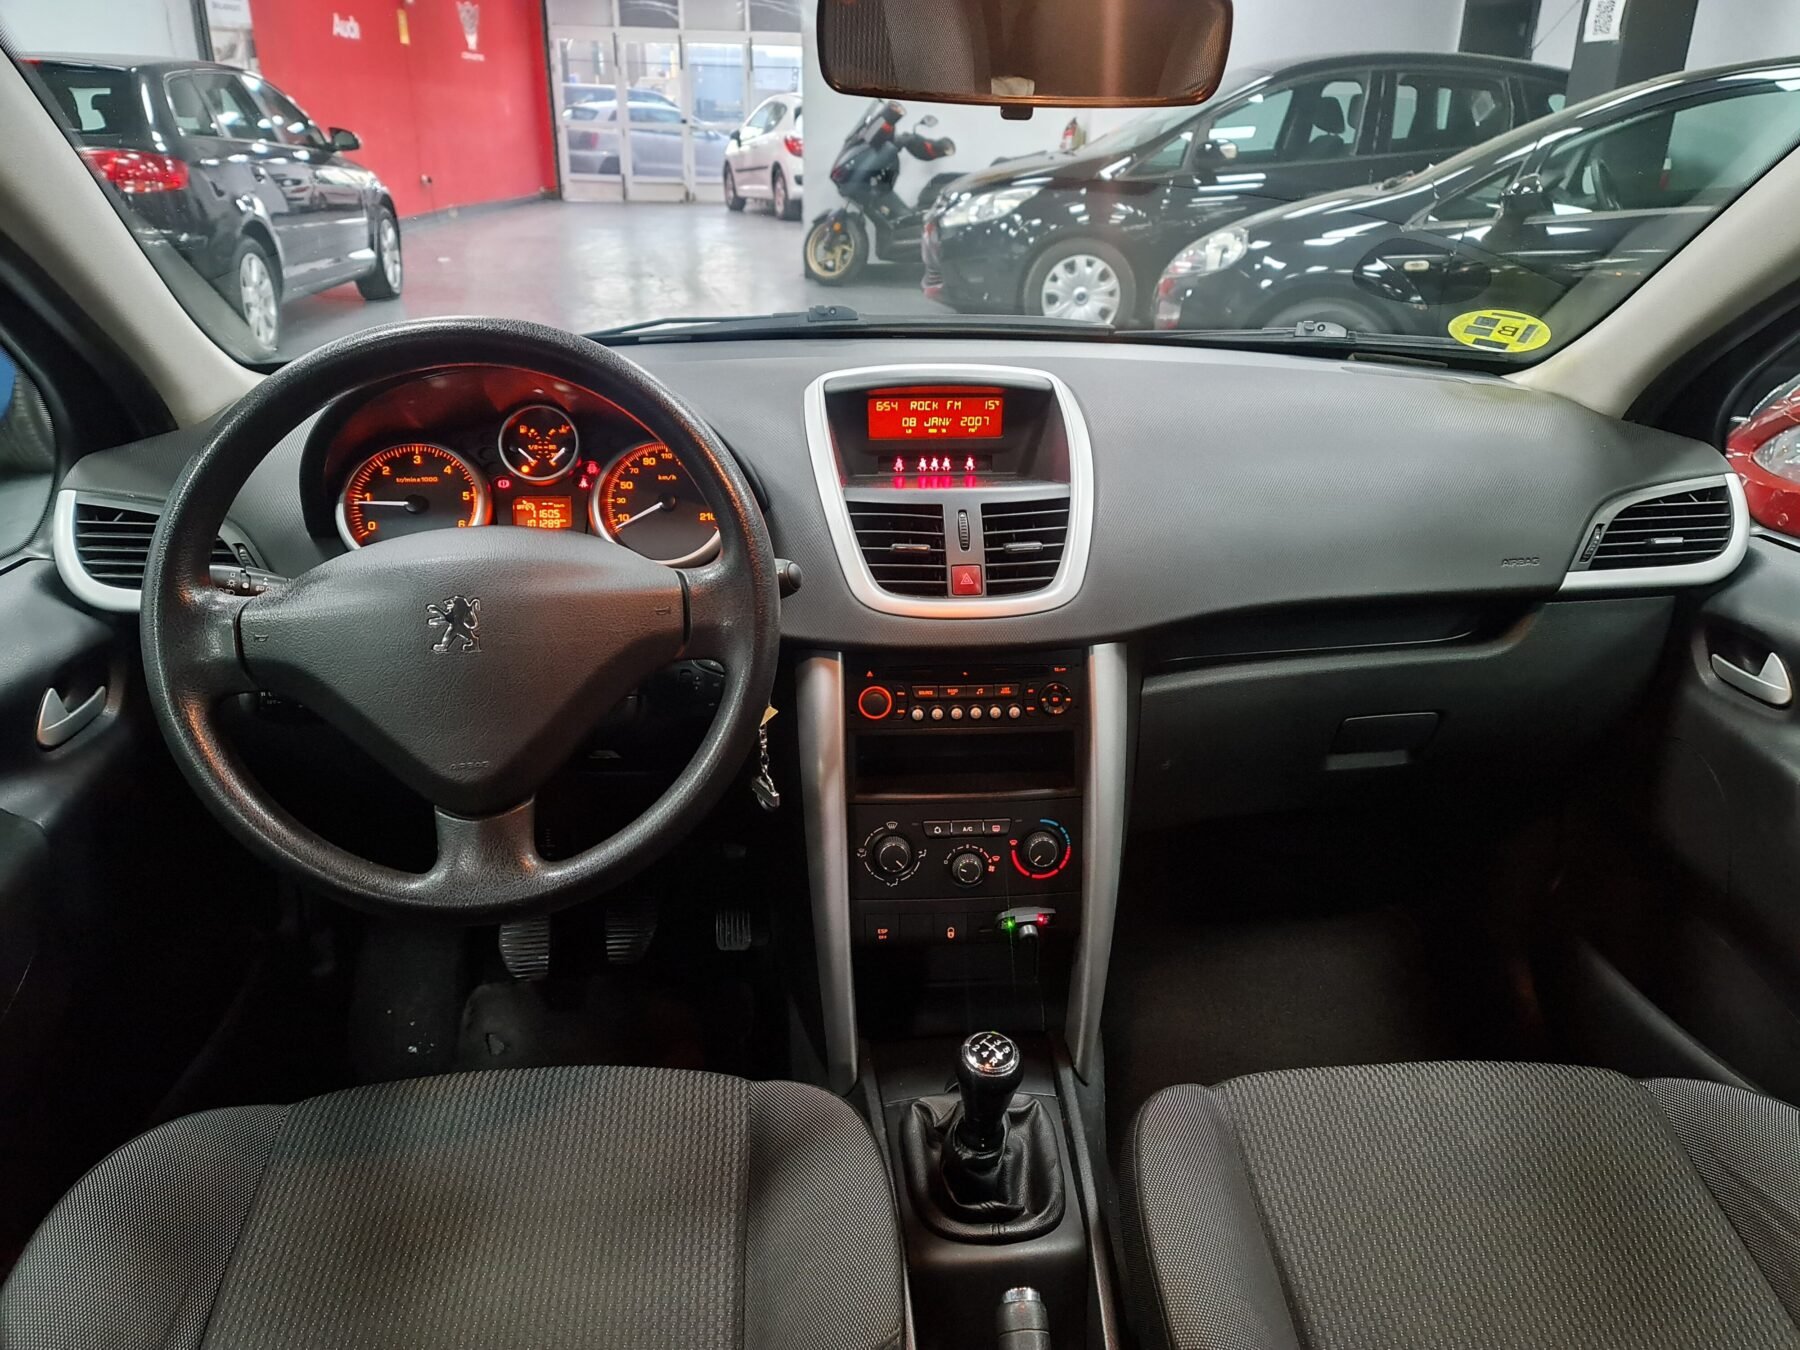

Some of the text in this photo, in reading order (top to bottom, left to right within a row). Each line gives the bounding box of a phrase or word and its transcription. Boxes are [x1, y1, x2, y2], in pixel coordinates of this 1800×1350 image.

[876, 401, 898, 411] 654
[910, 401, 938, 411] ROCK
[946, 401, 962, 411] FM
[901, 416, 990, 427] 08 JANV 2007
[413, 455, 421, 465] 3
[643, 457, 656, 466] 90
[382, 466, 391, 475] 2
[443, 465, 452, 474] 4
[620, 481, 633, 490] 50
[364, 492, 371, 501] 1
[462, 491, 470, 500] 5
[617, 513, 630, 522] 10
[367, 521, 376, 531] 0
[1002, 1045, 1011, 1054] 5
[989, 1057, 998, 1066] R
